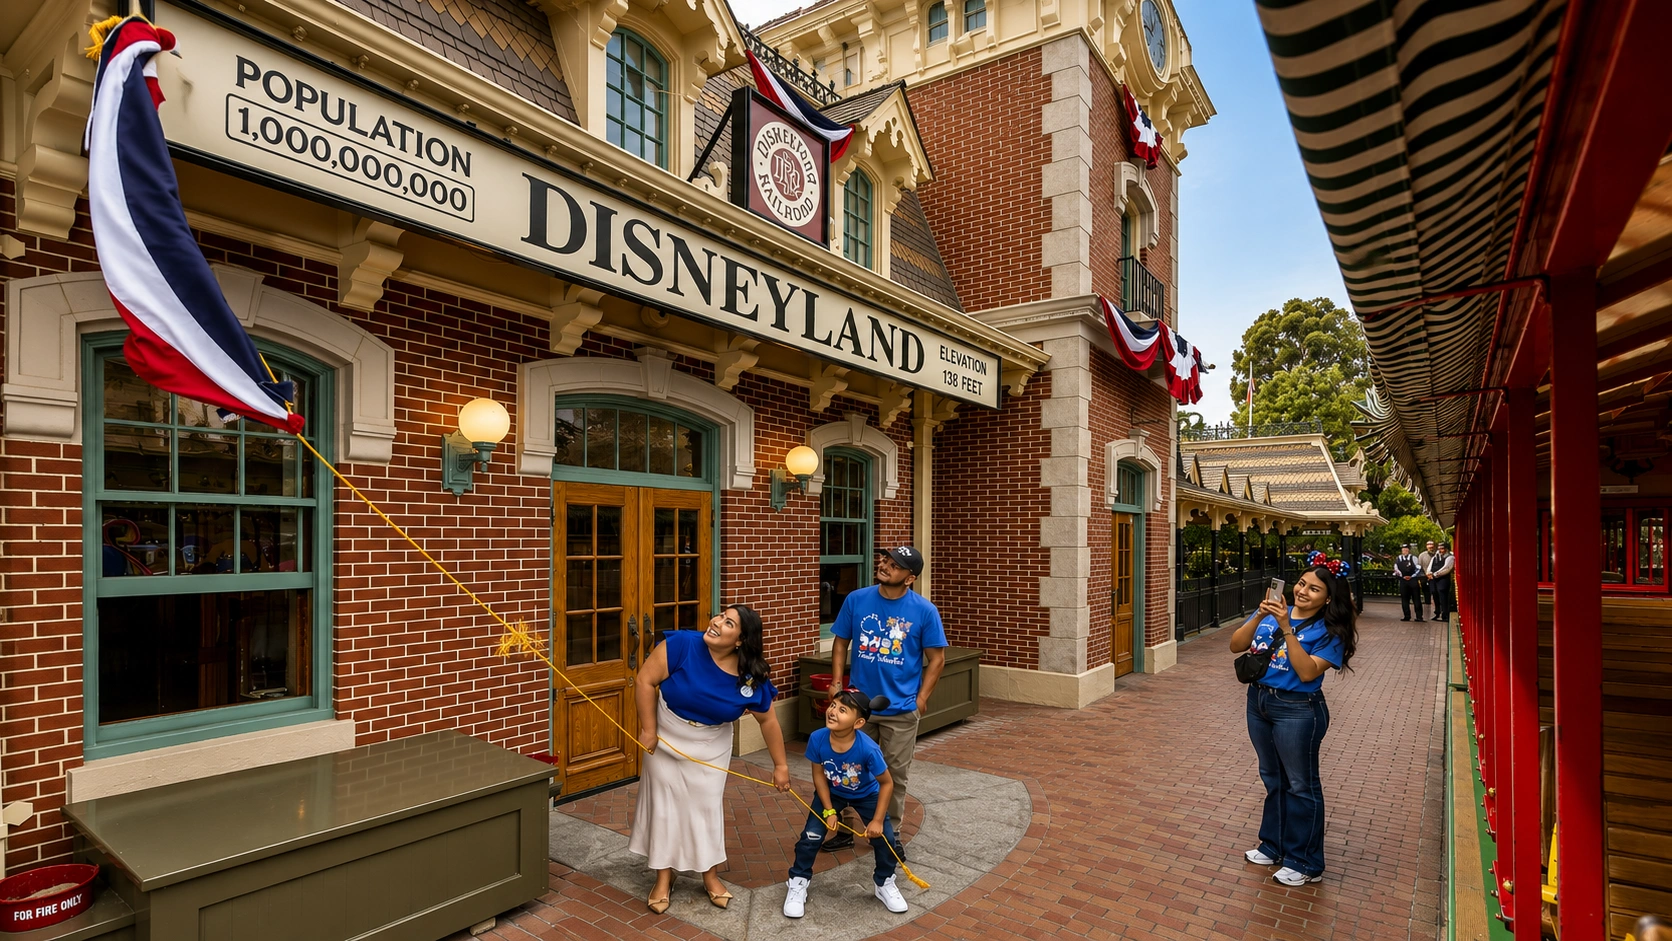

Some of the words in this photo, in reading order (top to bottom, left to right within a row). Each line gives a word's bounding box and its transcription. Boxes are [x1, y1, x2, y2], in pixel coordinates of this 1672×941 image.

[236, 55, 471, 178] POPULATION
[238, 107, 467, 212] 1,000,000,000
[521, 172, 925, 374] DISNEYLAND
[940, 344, 987, 376] ELEVATION
[943, 369, 959, 388] 138
[961, 375, 983, 396] FEET
[13, 909, 33, 921] FOR
[35, 903, 58, 918] FIRE
[60, 893, 83, 911] ONLY
